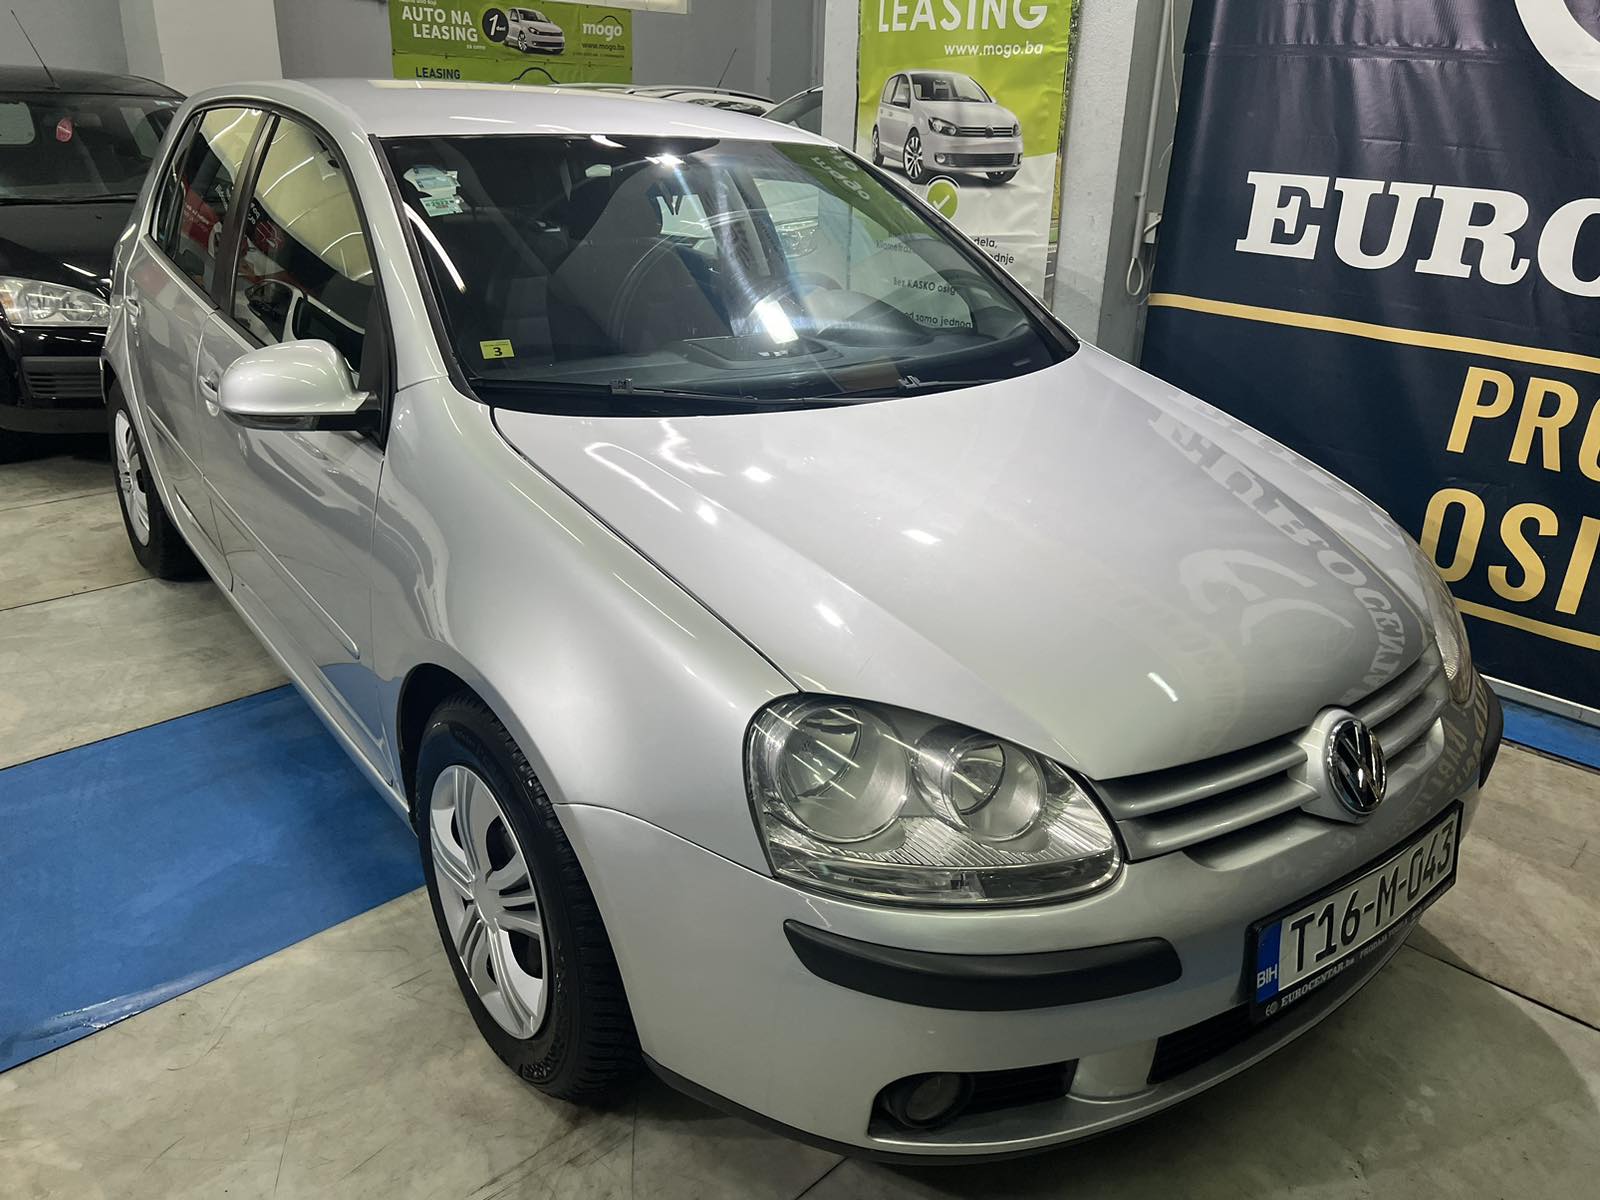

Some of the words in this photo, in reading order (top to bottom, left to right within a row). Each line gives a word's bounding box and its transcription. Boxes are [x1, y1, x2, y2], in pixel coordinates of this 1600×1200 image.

[402, 5, 446, 23] AUTO
[451, 10, 473, 26] NA
[878, 0, 1048, 33] LEASING
[413, 23, 478, 42] LEASING
[489, 14, 499, 36] 1
[583, 23, 622, 41] mogo
[944, 41, 1044, 58] www.mogo.ba
[415, 66, 461, 80] LEASING
[974, 236, 998, 249] dela,
[989, 252, 1015, 266] dnje
[916, 313, 938, 324] samo
[493, 347, 503, 357] 3
[1420, 488, 1600, 615] OSI
[1290, 820, 1455, 973] T16-M-043
[1257, 964, 1278, 989] BIH
